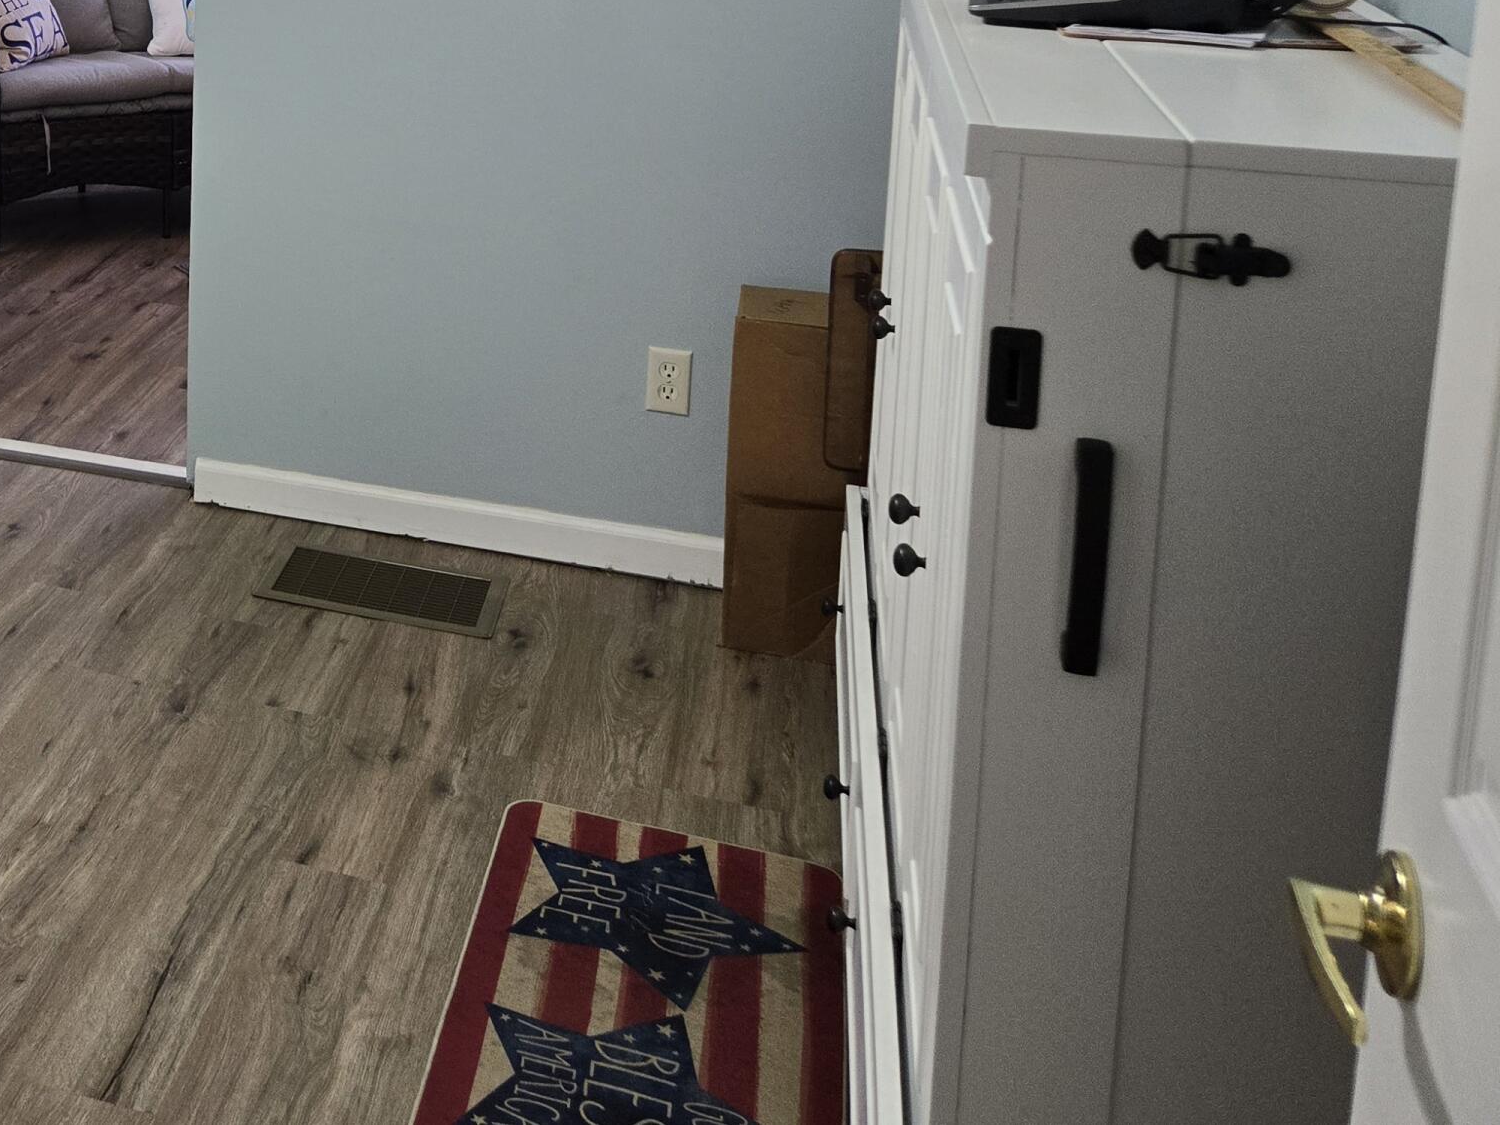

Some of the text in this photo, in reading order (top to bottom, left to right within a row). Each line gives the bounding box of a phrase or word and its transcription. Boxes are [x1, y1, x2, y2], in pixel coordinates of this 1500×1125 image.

[0, 5, 69, 65] SEA
[539, 862, 627, 935] FREE
[647, 882, 735, 958] LAND
